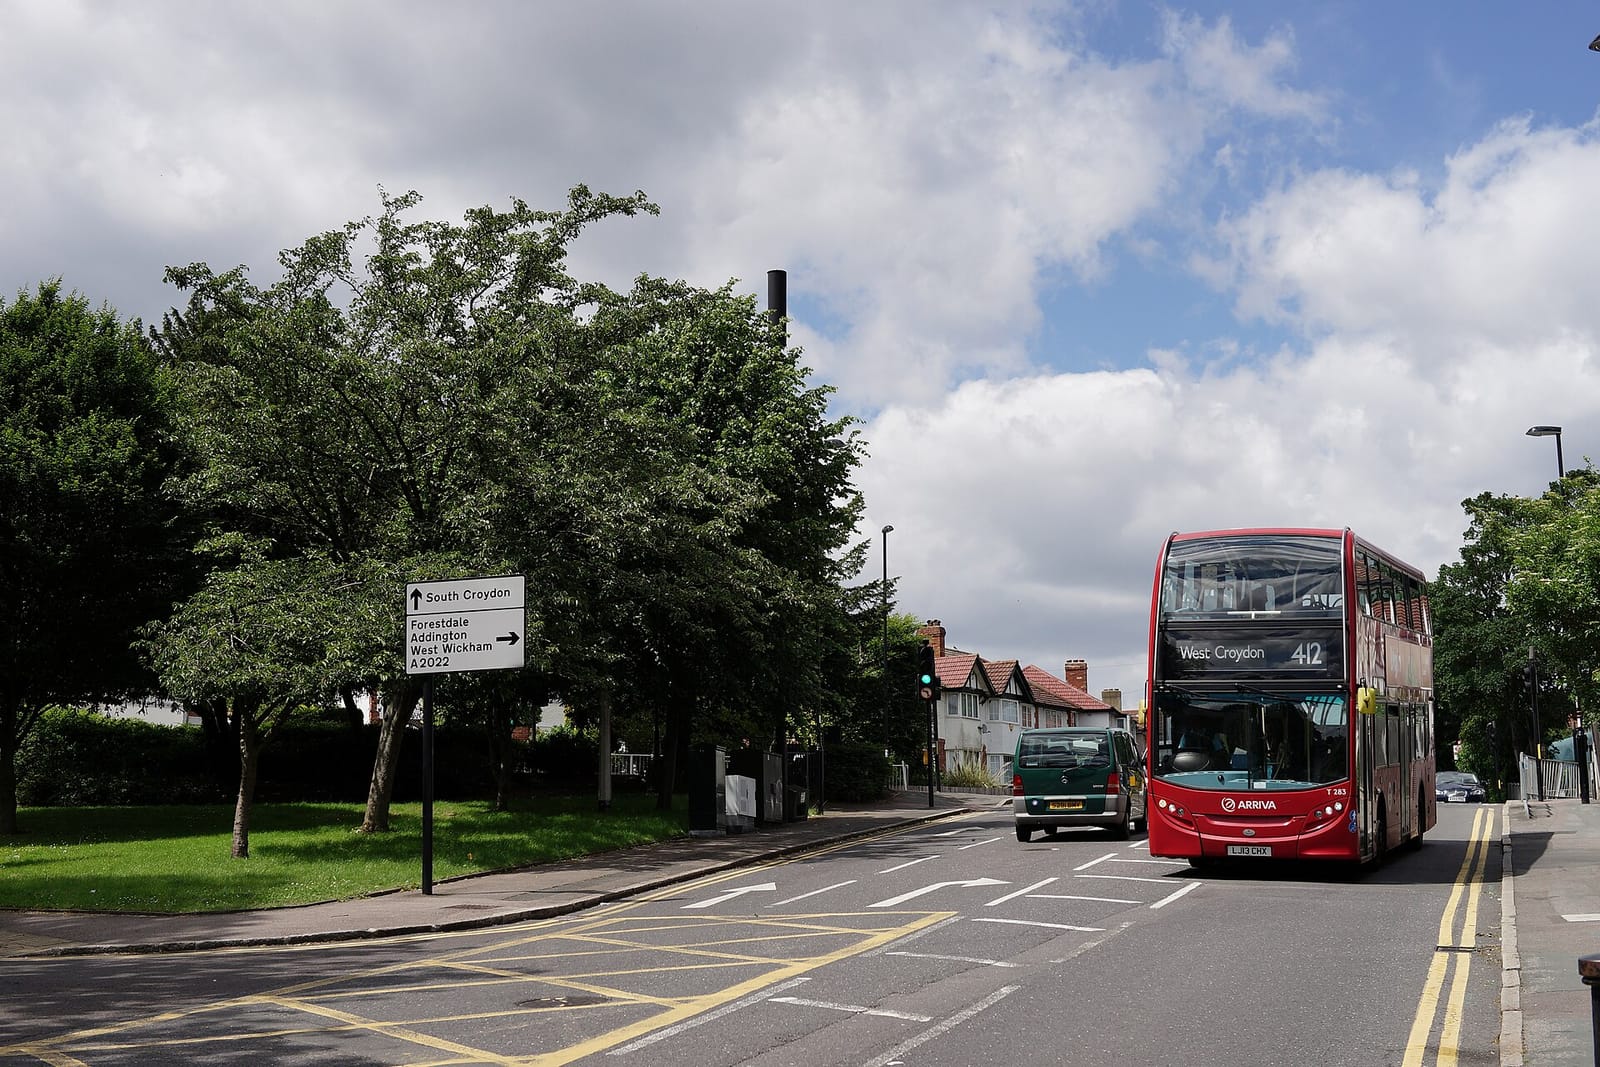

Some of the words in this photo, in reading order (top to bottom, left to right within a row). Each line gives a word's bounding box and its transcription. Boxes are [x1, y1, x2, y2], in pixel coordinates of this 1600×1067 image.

[426, 591, 459, 603] South
[463, 588, 511, 600] Croydon
[411, 617, 469, 630] Forestdale
[410, 631, 467, 643] Addington
[411, 644, 438, 655] West
[442, 642, 493, 654] Wickham
[1180, 646, 1210, 659] West
[1214, 645, 1265, 662] Croydon
[1291, 642, 1322, 664] 412
[410, 656, 450, 668] A2022
[1238, 800, 1276, 810] ARRIVA
[1232, 846, 1250, 854] LJ13
